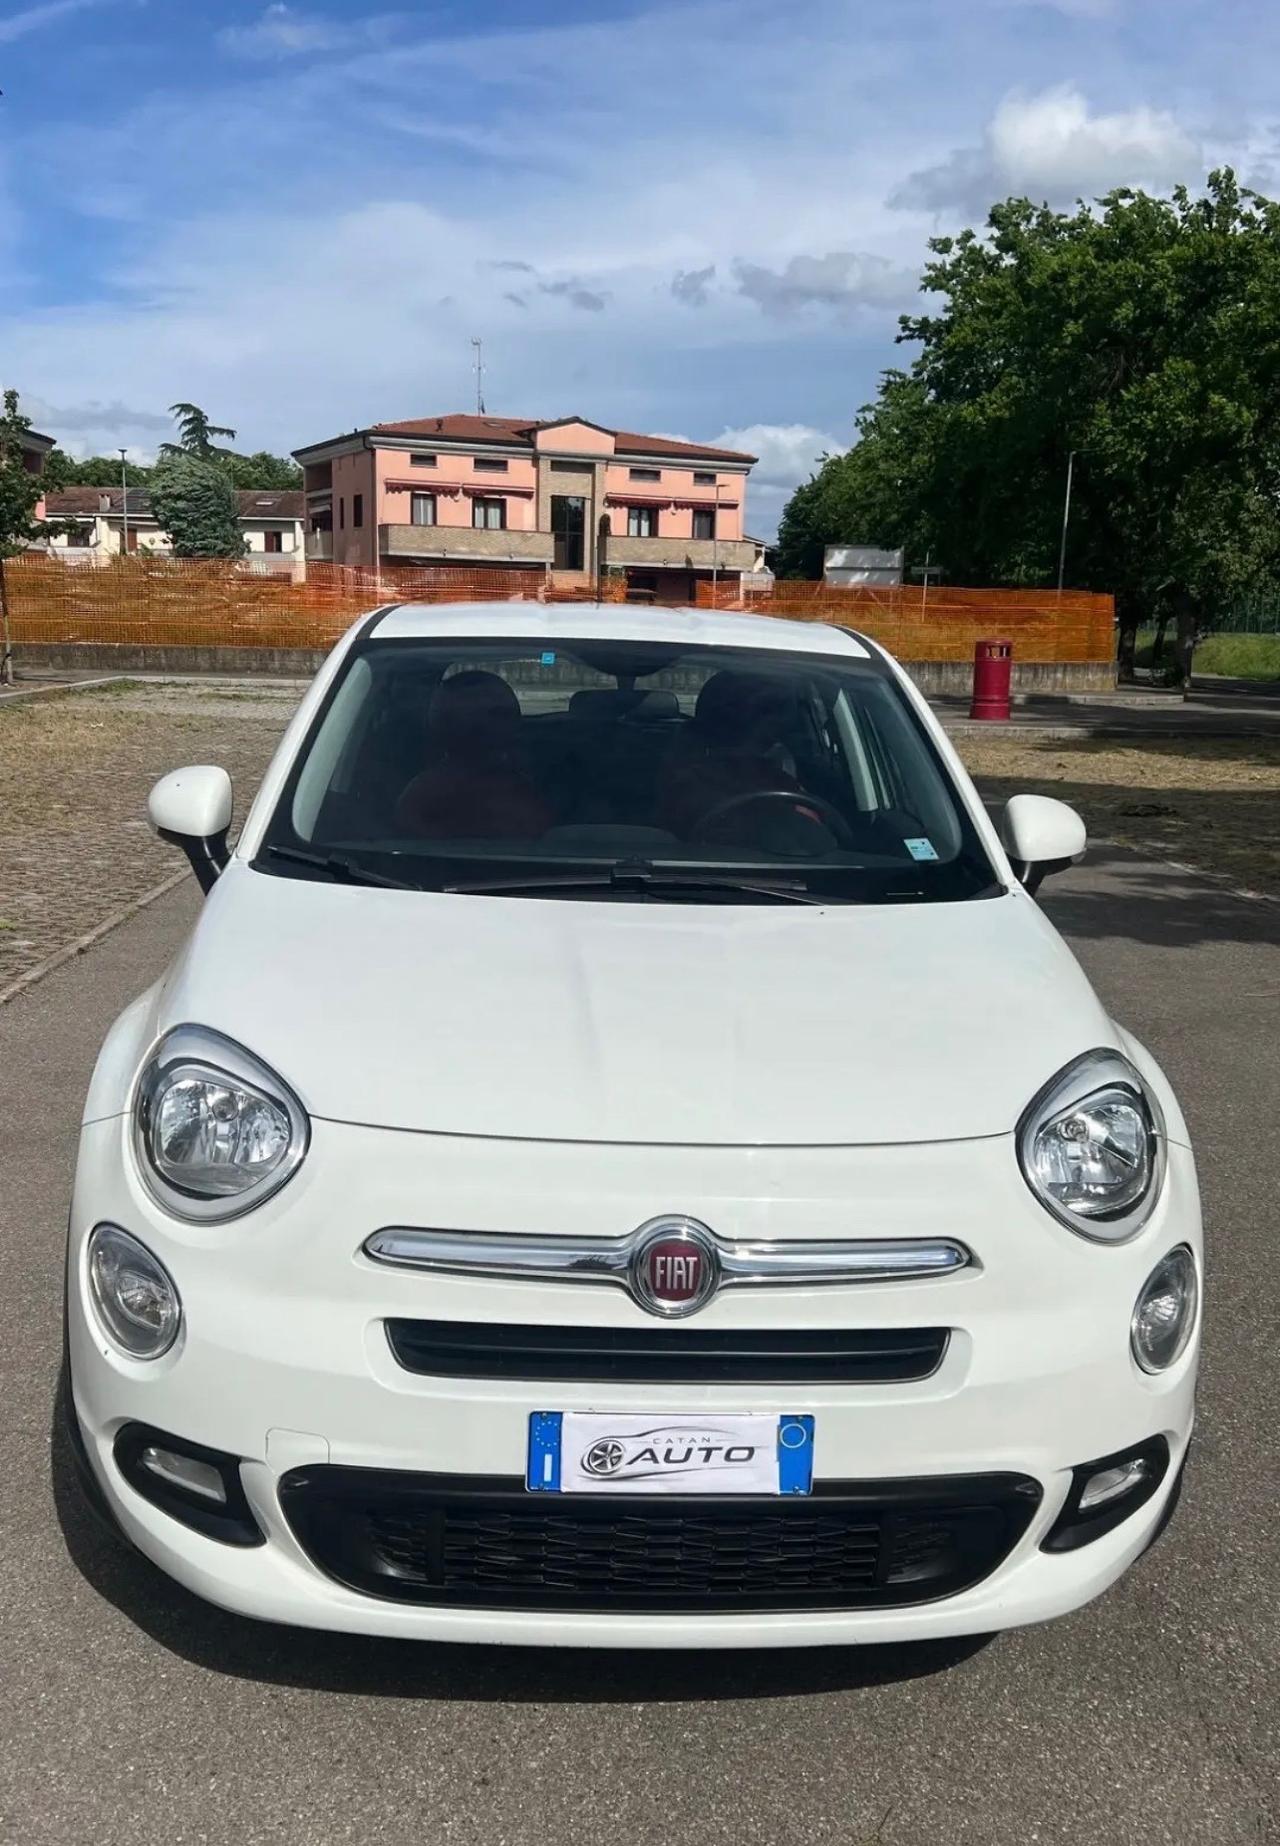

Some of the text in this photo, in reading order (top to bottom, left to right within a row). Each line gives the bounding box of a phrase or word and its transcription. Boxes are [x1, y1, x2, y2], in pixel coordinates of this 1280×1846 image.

[656, 1256, 698, 1290] FIAT
[652, 1436, 711, 1445] CATAN
[626, 1446, 755, 1465] AUTO
